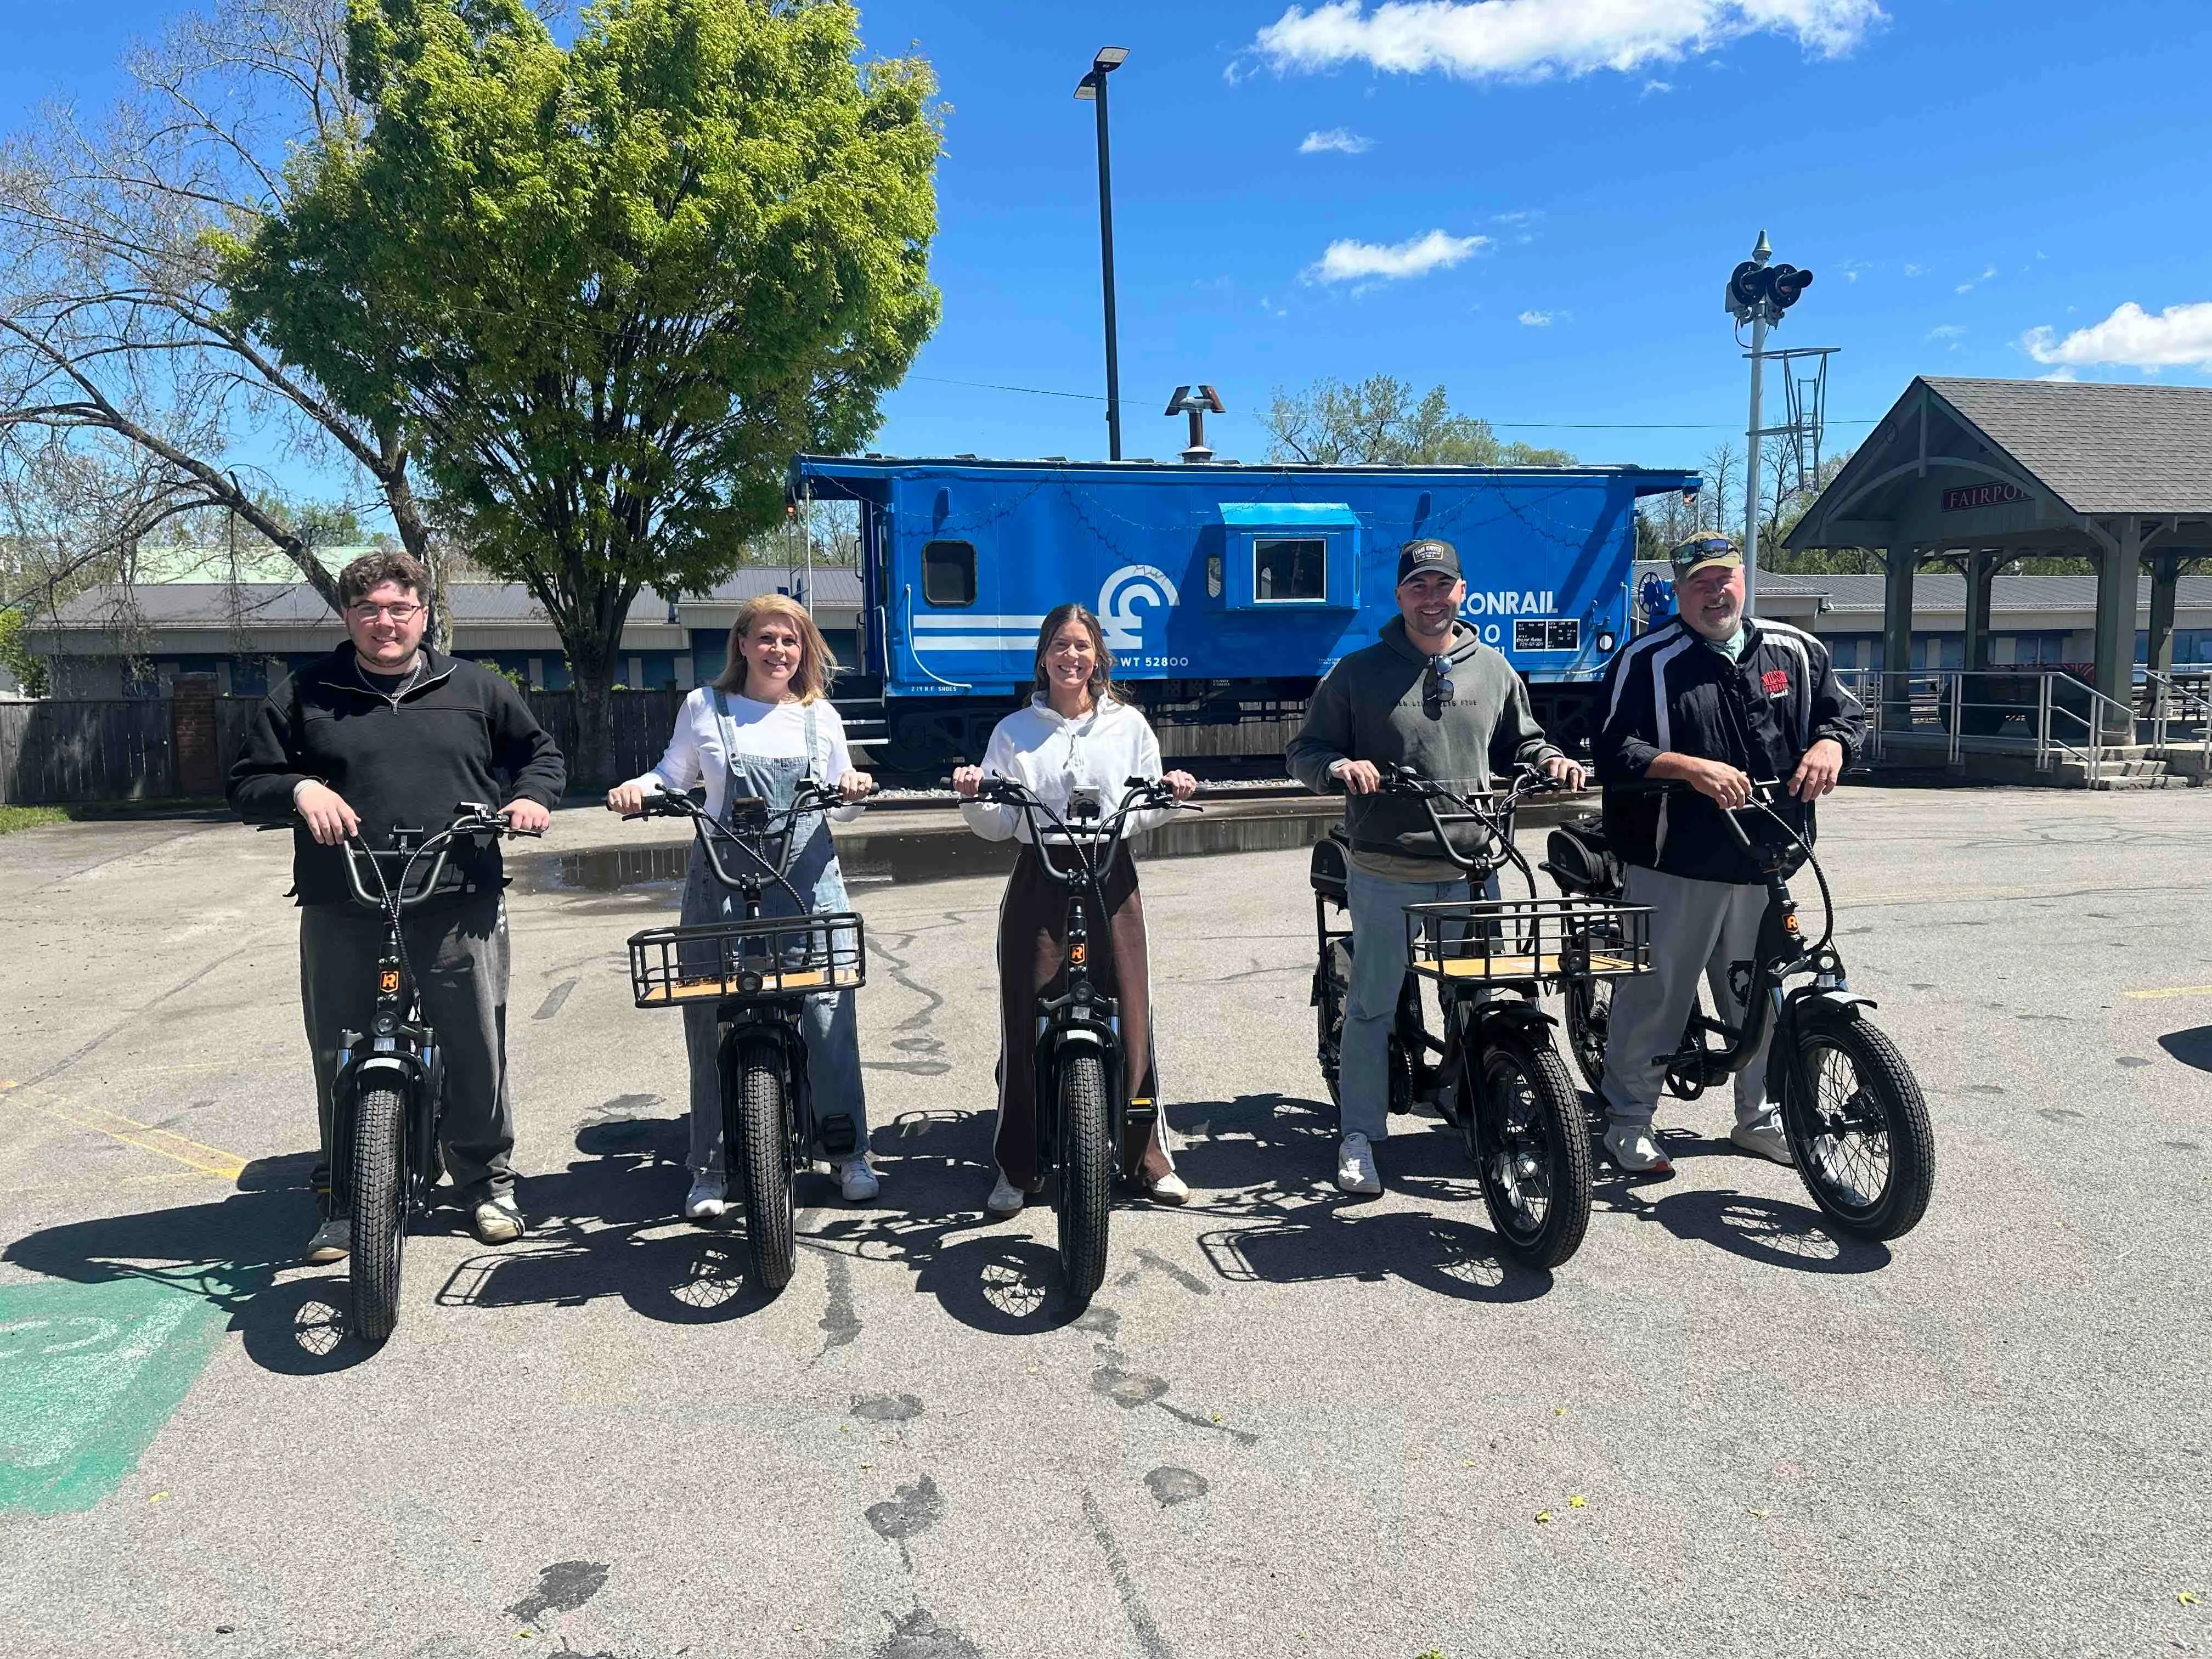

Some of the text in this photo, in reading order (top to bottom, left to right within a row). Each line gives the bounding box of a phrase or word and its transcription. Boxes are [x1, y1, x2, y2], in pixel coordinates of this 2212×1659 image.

[1949, 486, 2025, 508] FAIRPO
[1120, 657, 1189, 667] WT 52800
[1071, 946, 1084, 960] R
[382, 973, 397, 988] R
